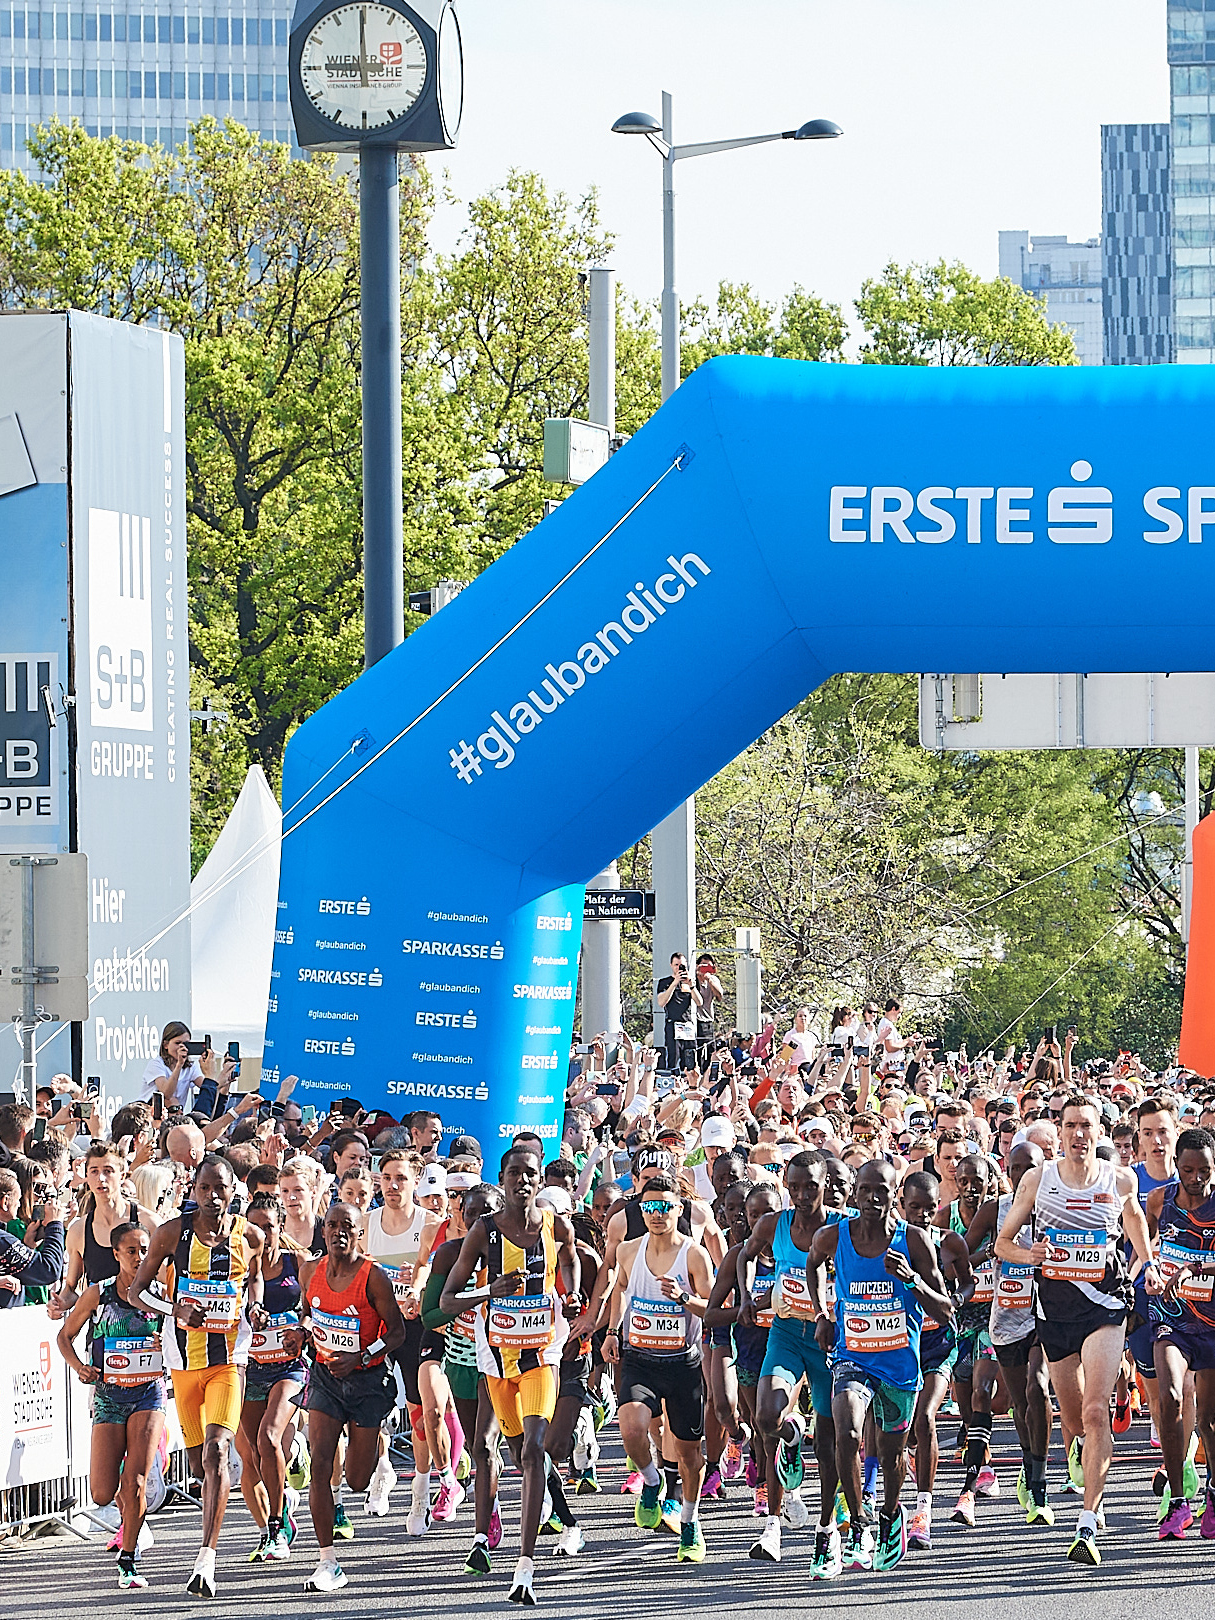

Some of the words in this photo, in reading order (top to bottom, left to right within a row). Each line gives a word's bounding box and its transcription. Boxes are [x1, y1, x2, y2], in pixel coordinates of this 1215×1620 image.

[164, 443, 173, 563] SUCCESS
[829, 485, 1034, 544] ERSTE
[165, 571, 175, 641] REAL
[449, 552, 712, 785] #glaubandich
[97, 645, 147, 713] S+B
[167, 648, 177, 783] CREATING
[91, 740, 154, 780] GRUPPE
[92, 877, 126, 923] Hier
[609, 894, 626, 904] der
[318, 899, 356, 915] ERSTE
[598, 905, 640, 916] Nationen
[427, 911, 489, 924] #glaubandich
[536, 915, 565, 931] ERSTE
[315, 939, 367, 951] #glaubandich
[402, 939, 489, 959] SPARKASSE
[93, 946, 169, 993] entstehen
[298, 968, 367, 986] SPARKASSE
[419, 981, 481, 994] #glaubandich
[513, 984, 567, 1000] SPARKASSE
[308, 1010, 359, 1021] #glaubandich
[415, 1011, 461, 1028] ERSTE
[95, 1015, 159, 1072] Projekte
[304, 1039, 341, 1055] ERSTE
[412, 1052, 473, 1065] #glaubandich
[521, 1055, 550, 1070] ERSTE
[300, 1079, 352, 1091] #glaubandich
[386, 1080, 474, 1100] SPARKASSE
[1056, 1234, 1084, 1243] ERSTE
[1075, 1251, 1100, 1262] M29
[1162, 1246, 1206, 1263] SPARKASSE
[1008, 1266, 1035, 1276] ERSTE
[1076, 1271, 1102, 1279] ENERGIE
[188, 1282, 216, 1294] ERSTE
[849, 1281, 893, 1295] RUNCZECH
[1184, 1290, 1210, 1298] ENERGIE
[208, 1301, 231, 1313] M43
[493, 1297, 541, 1308] SPARKASSE
[633, 1300, 674, 1313] SPARKASSE
[845, 1302, 893, 1311] SPARKASSE
[522, 1314, 546, 1328] M44
[656, 1319, 680, 1331] M34
[876, 1317, 901, 1330] M42
[115, 1340, 142, 1349] ERSTE
[331, 1333, 354, 1347] M26
[504, 1337, 522, 1345] WIEN
[523, 1335, 549, 1345] ENERGIE
[880, 1337, 906, 1347] ENERGIE
[139, 1354, 153, 1367] F7
